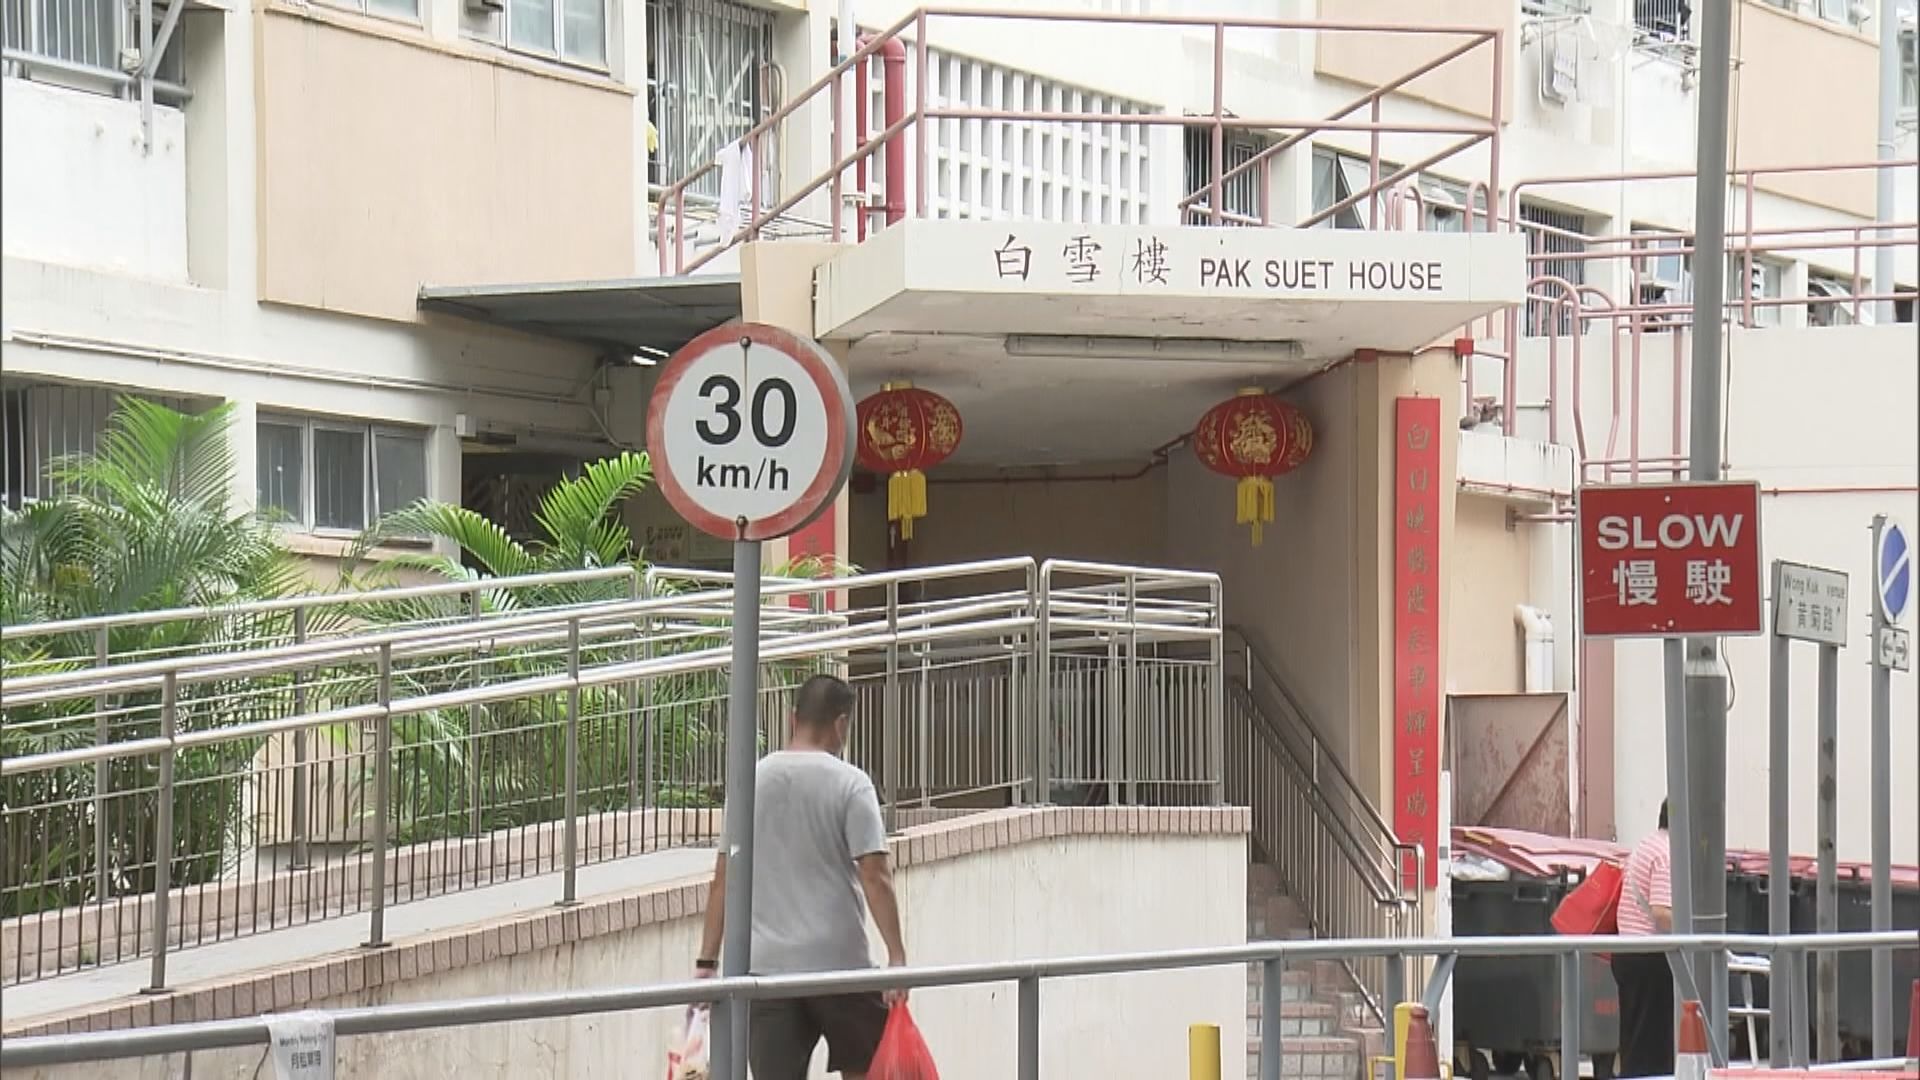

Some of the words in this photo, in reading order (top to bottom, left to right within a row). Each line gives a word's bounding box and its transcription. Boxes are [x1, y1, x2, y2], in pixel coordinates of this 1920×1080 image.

[994, 233, 1171, 285] 白雪樓
[1200, 258, 1252, 288] PAK
[1264, 260, 1334, 290] SUET
[1349, 262, 1442, 291] HOUSE
[695, 374, 798, 448] 30
[696, 456, 790, 491] km/h
[1597, 513, 1744, 550] SLOW
[1612, 558, 1733, 606] 慢駛
[1783, 572, 1805, 596] Wong
[1806, 575, 1819, 595] Kuk
